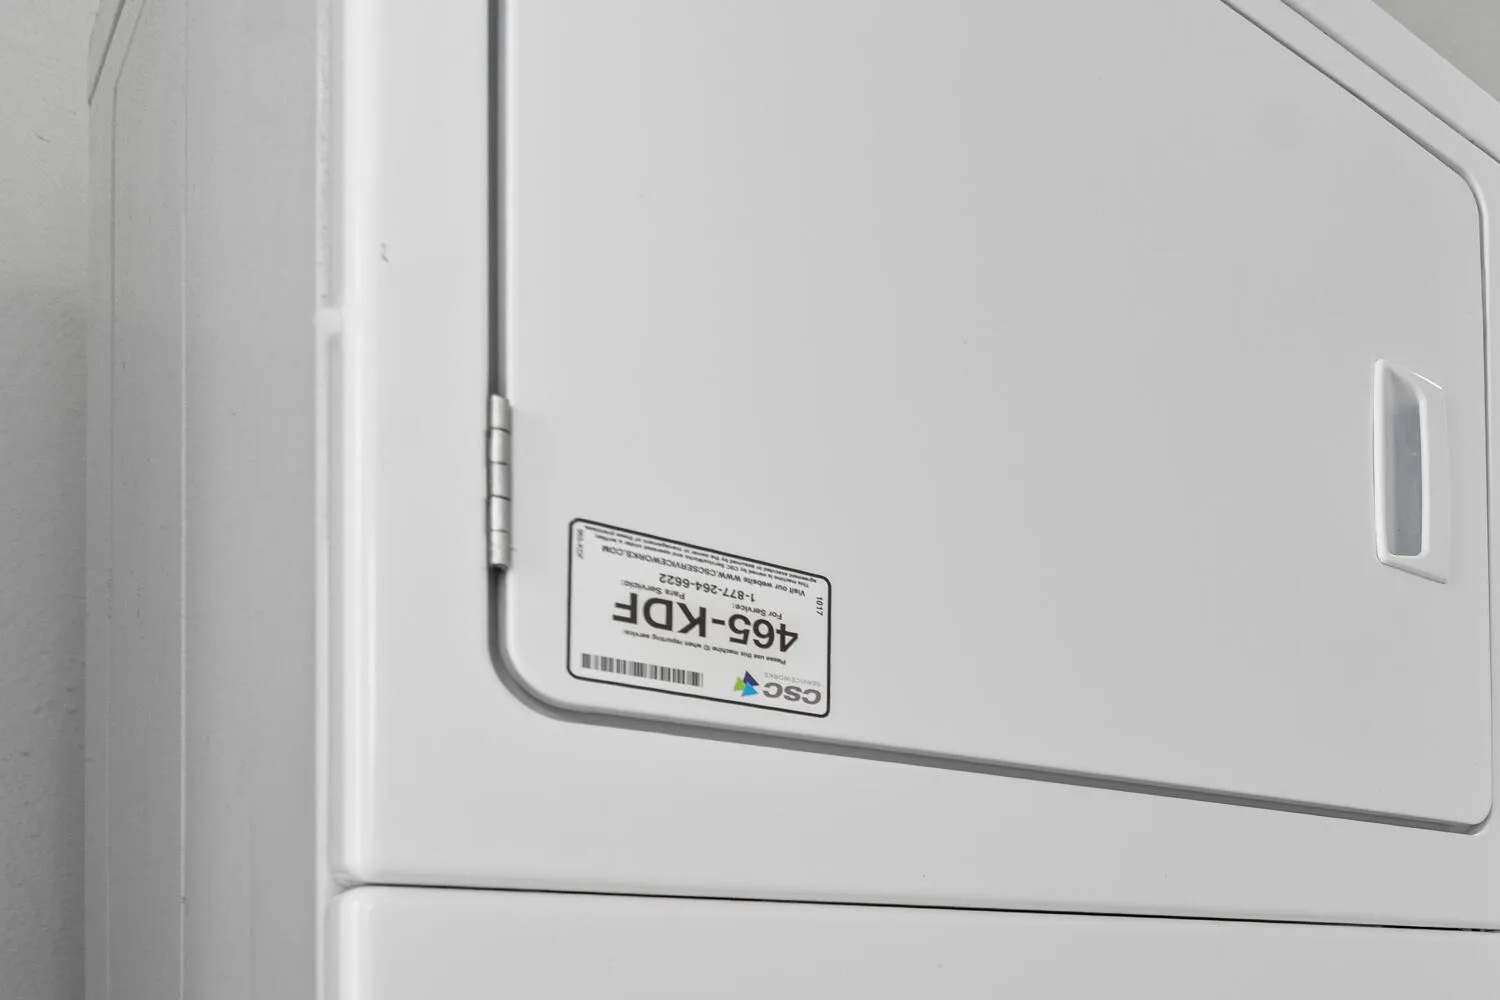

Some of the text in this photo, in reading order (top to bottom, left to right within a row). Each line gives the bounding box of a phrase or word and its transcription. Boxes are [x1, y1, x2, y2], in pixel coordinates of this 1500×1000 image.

[601, 545, 805, 596] Visit our website WWW.CSCSERVICEWORKS.COM
[620, 579, 685, 600] Para Servicio:
[659, 572, 755, 602] 1-877-264-6622
[612, 589, 798, 655] 465-KDF
[732, 603, 782, 620] For Service:
[764, 671, 820, 687] SERVICEWORKS
[762, 680, 821, 706] CSC
